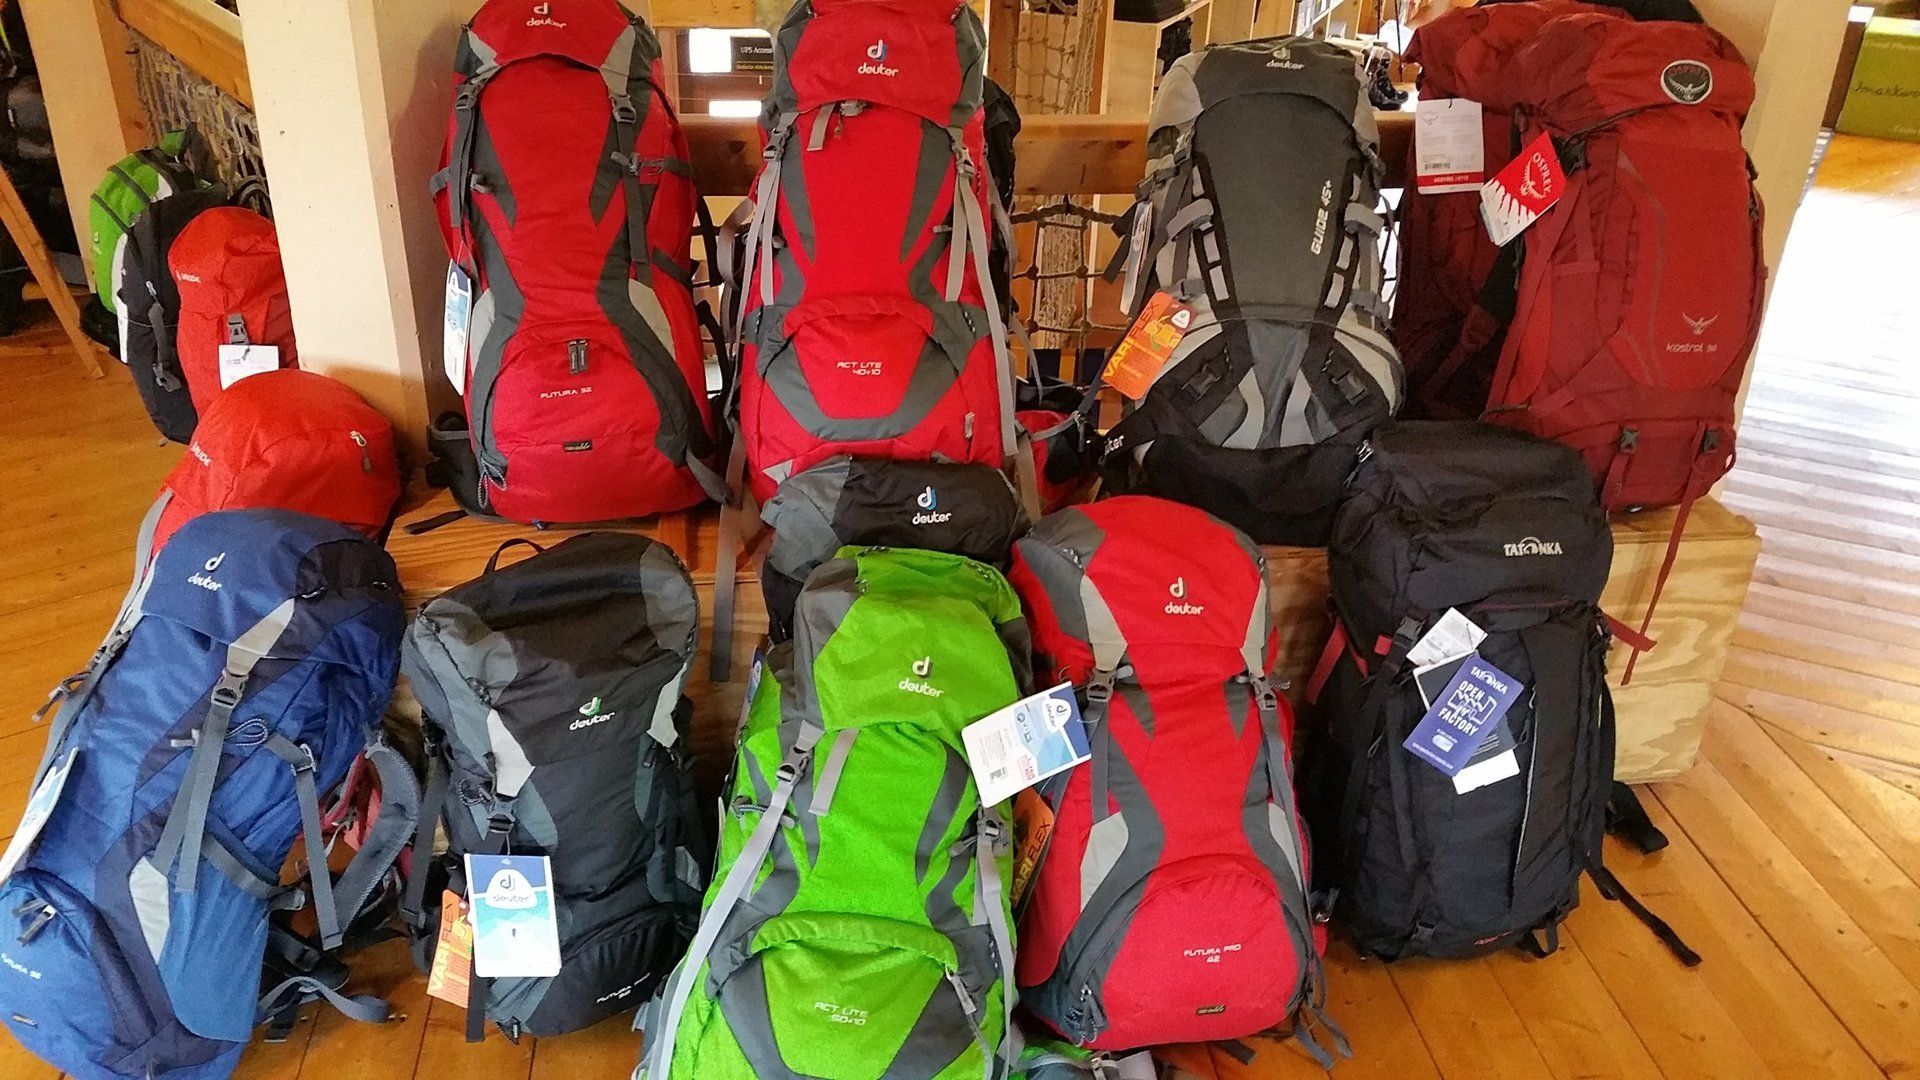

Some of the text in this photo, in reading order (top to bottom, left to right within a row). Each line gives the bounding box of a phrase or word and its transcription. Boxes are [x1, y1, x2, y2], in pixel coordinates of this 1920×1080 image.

[526, 18, 567, 29] deuter
[857, 62, 899, 77] deuter
[1532, 152, 1554, 194] OSPREY
[1310, 208, 1329, 255] GUIDE
[852, 368, 882, 376] 40+10
[540, 390, 578, 400] FUTURA
[912, 511, 952, 525] deuter
[1503, 536, 1563, 557] TATONKA
[187, 572, 222, 592] deuter
[1164, 601, 1204, 615] deuter
[898, 678, 944, 698] deuter
[1470, 666, 1509, 695] TATONKA
[1458, 680, 1486, 700] OPEN
[569, 712, 616, 731] deuter
[1438, 706, 1479, 736] FACTORY
[492, 894, 530, 903] deuter
[1183, 943, 1241, 958] FUTURA PRO
[1206, 955, 1220, 963] 42
[814, 1002, 868, 1018] ACT LITE
[831, 1014, 866, 1026] 50+10
